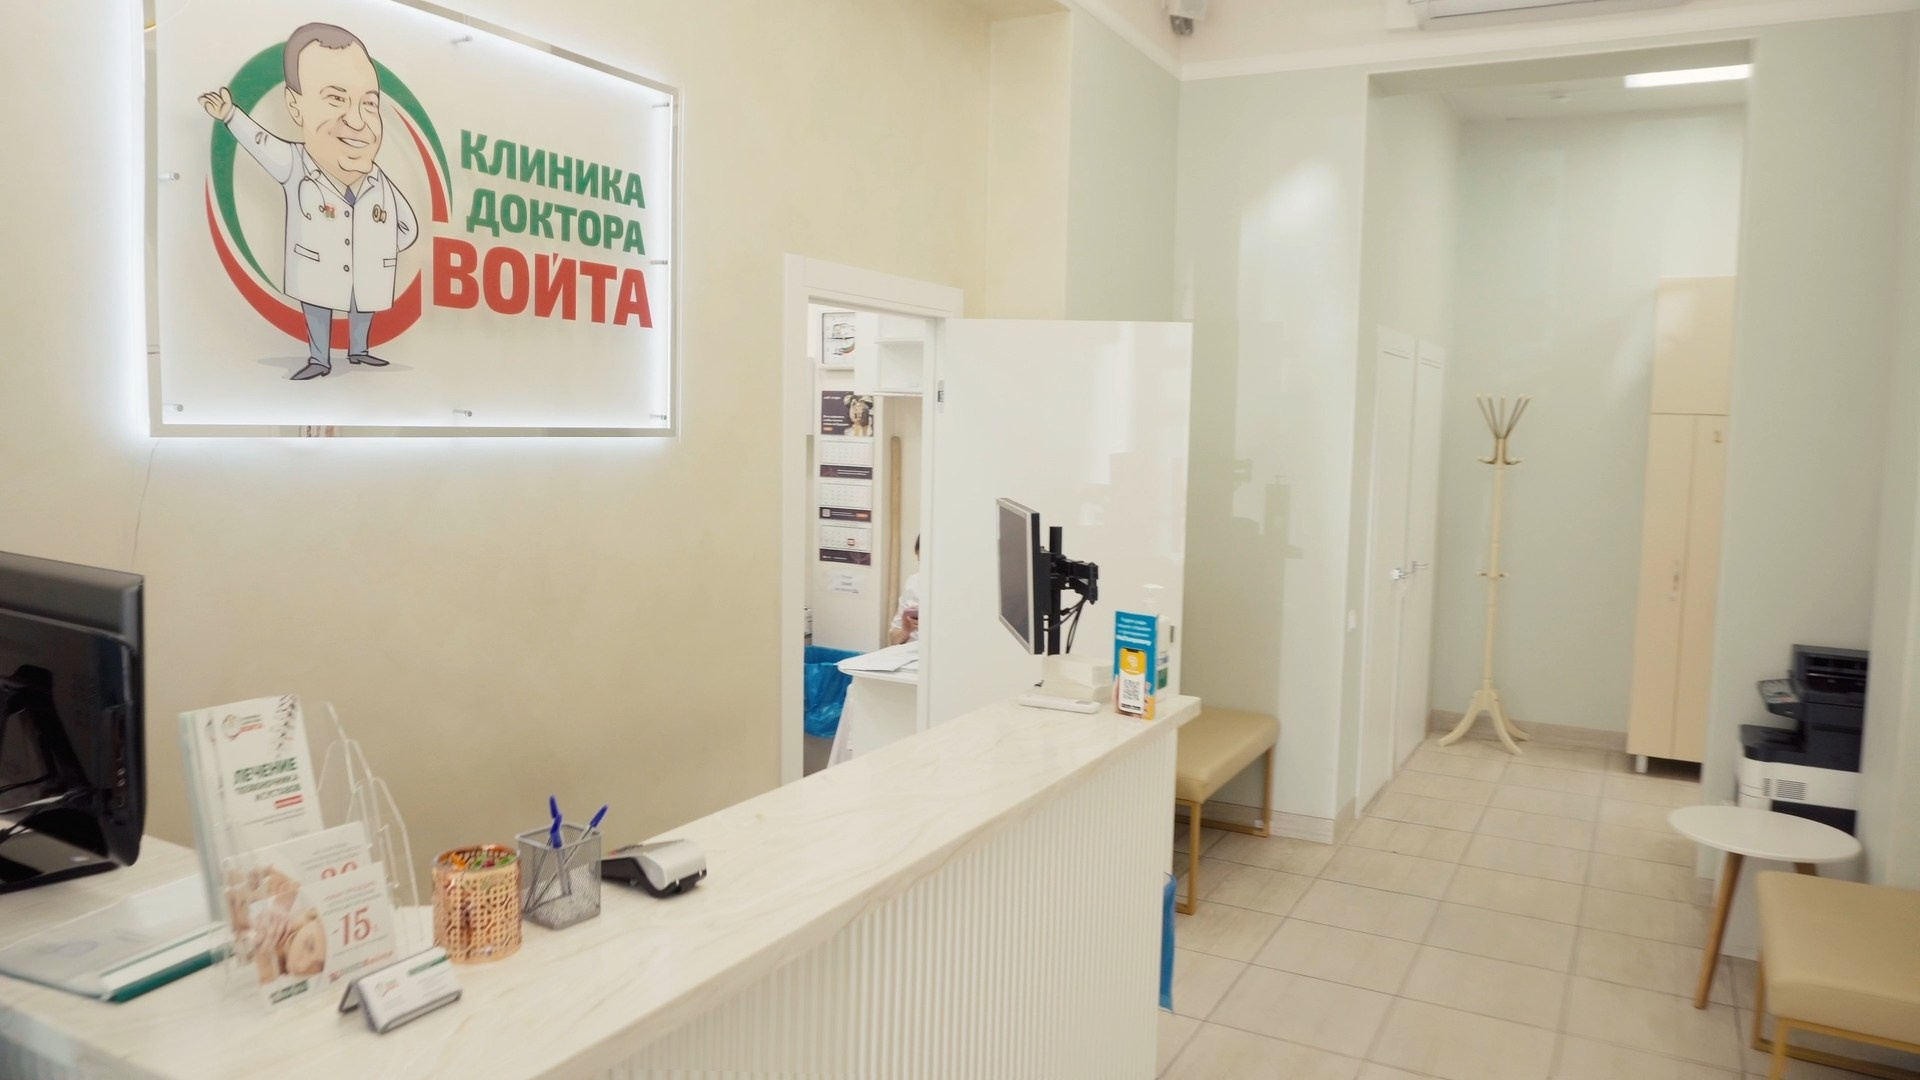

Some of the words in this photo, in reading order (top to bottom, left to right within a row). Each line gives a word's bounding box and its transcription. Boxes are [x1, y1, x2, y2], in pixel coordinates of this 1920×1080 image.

[461, 129, 646, 209] КЛИНИКА
[466, 188, 646, 255] ДОКТОРА
[433, 236, 653, 328] ВОЙТА
[233, 757, 298, 785] ЛЕЧЕНИЕ
